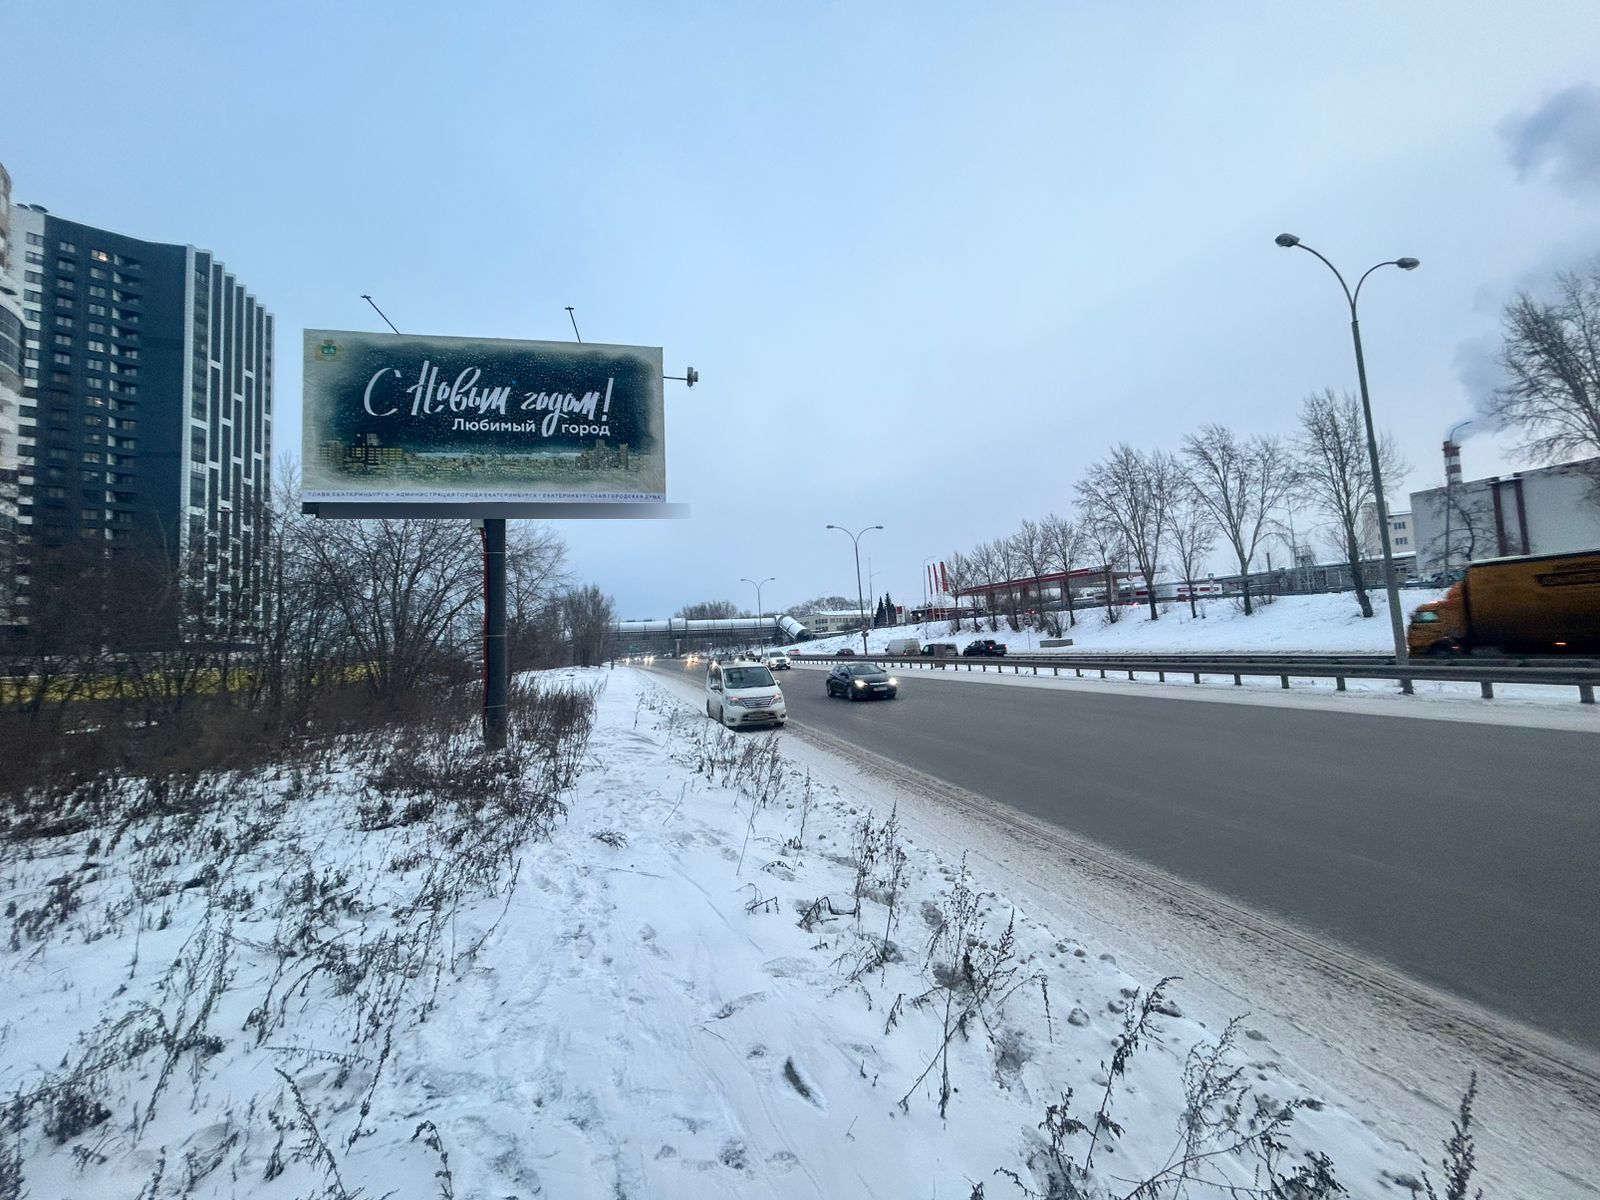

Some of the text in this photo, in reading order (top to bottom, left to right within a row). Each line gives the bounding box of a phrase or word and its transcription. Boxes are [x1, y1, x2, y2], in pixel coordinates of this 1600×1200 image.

[363, 359, 615, 438] С Новым годом!
[452, 416, 611, 437] Любимый город
